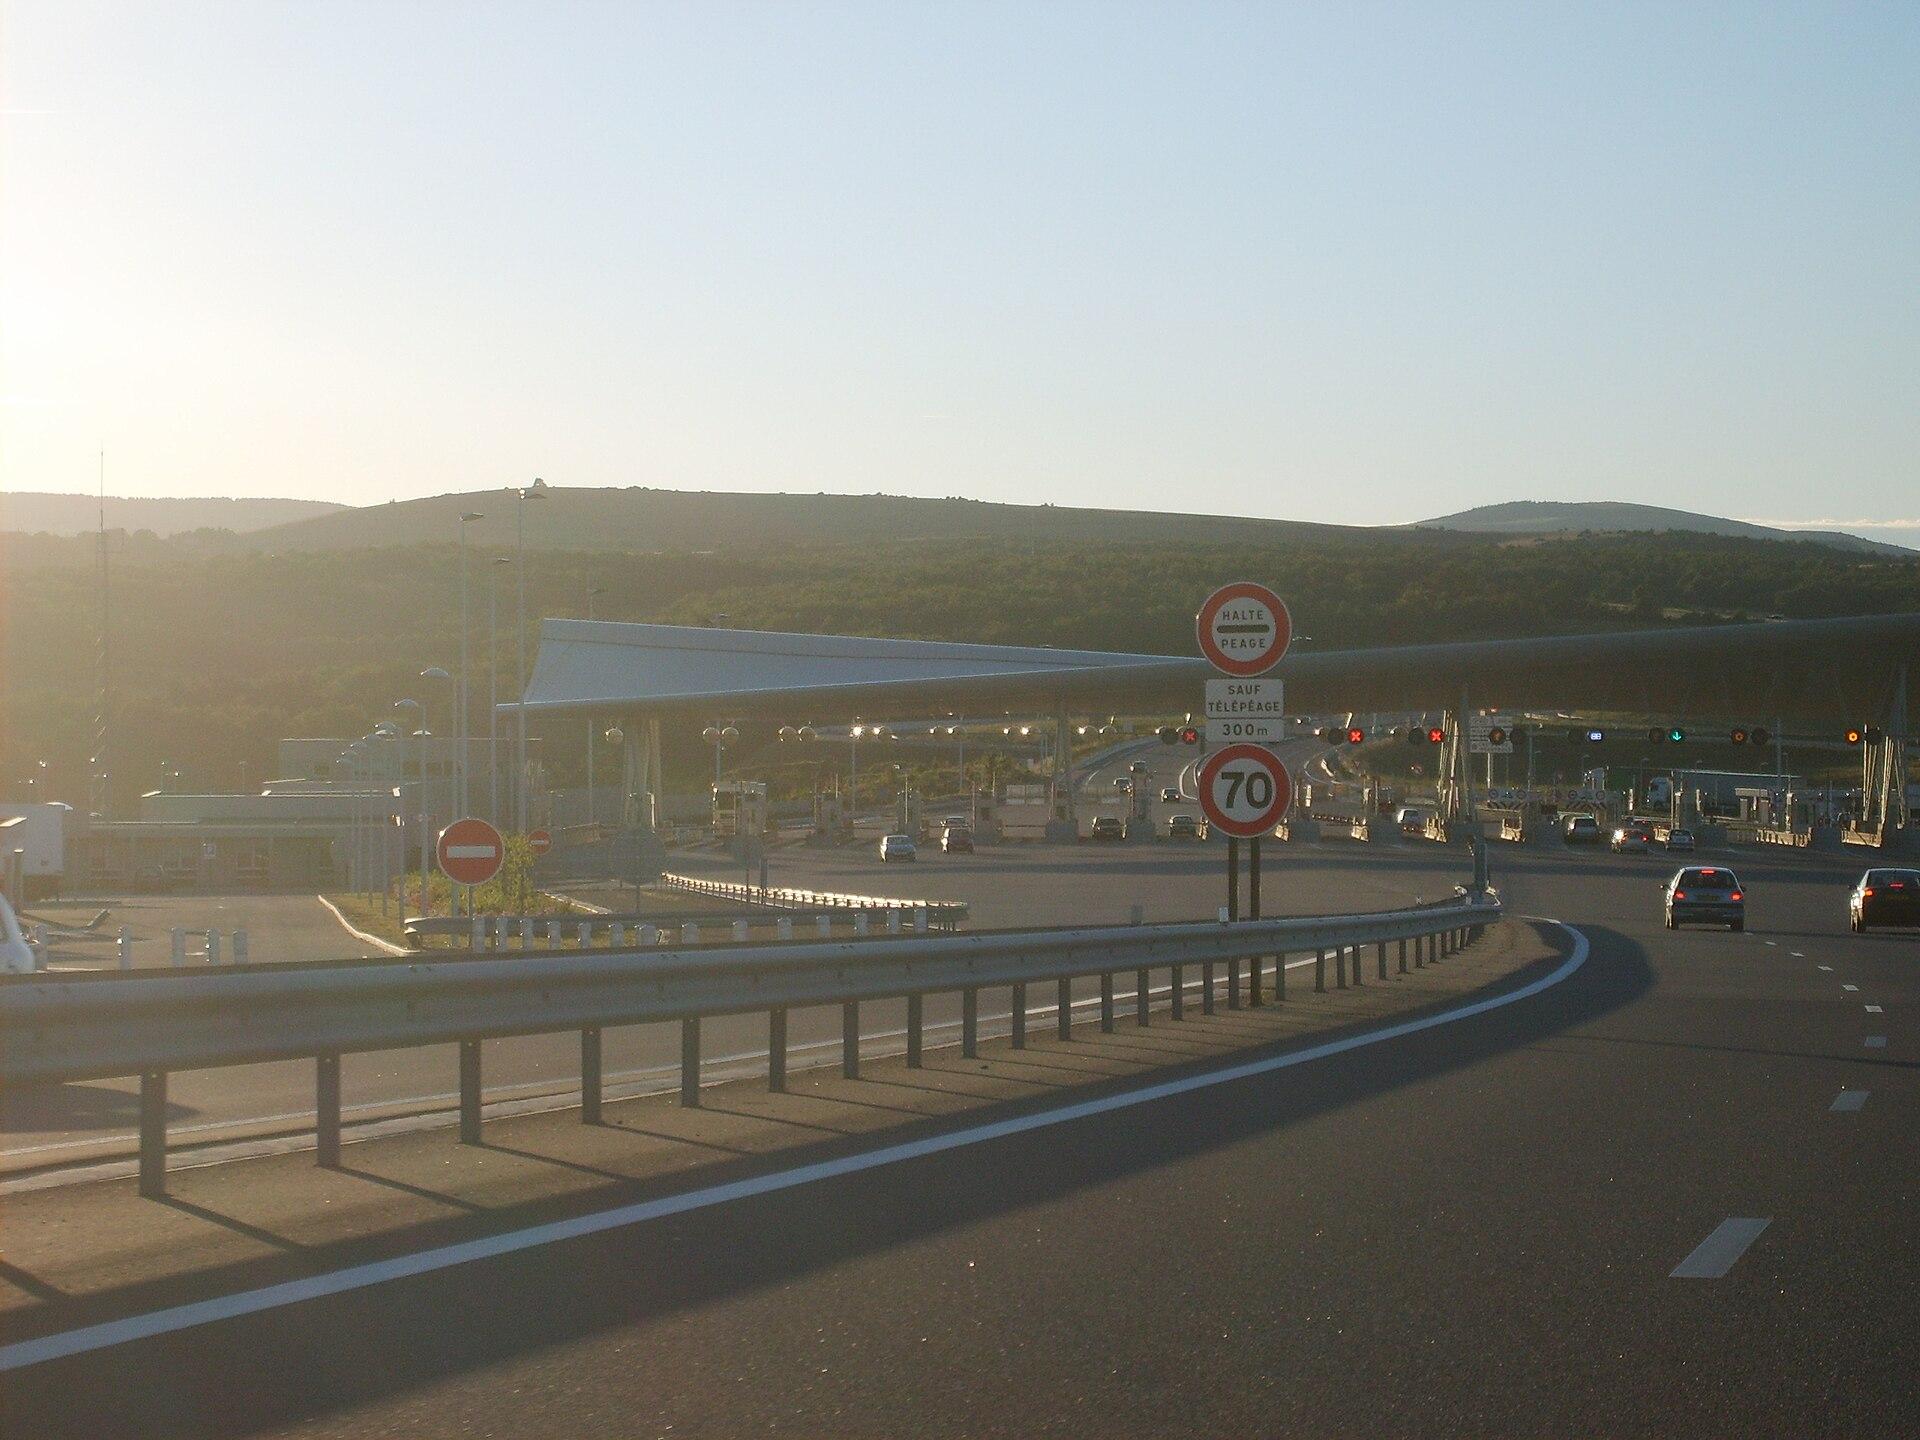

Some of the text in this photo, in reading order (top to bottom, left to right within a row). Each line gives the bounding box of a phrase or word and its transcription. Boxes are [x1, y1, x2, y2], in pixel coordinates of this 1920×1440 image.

[1222, 610, 1264, 621] HALTE
[1221, 638, 1266, 649] PEAGE
[1228, 685, 1262, 696] SAUF
[1208, 699, 1281, 712] TÉLÉPÉAGE
[1220, 771, 1273, 810] 70
